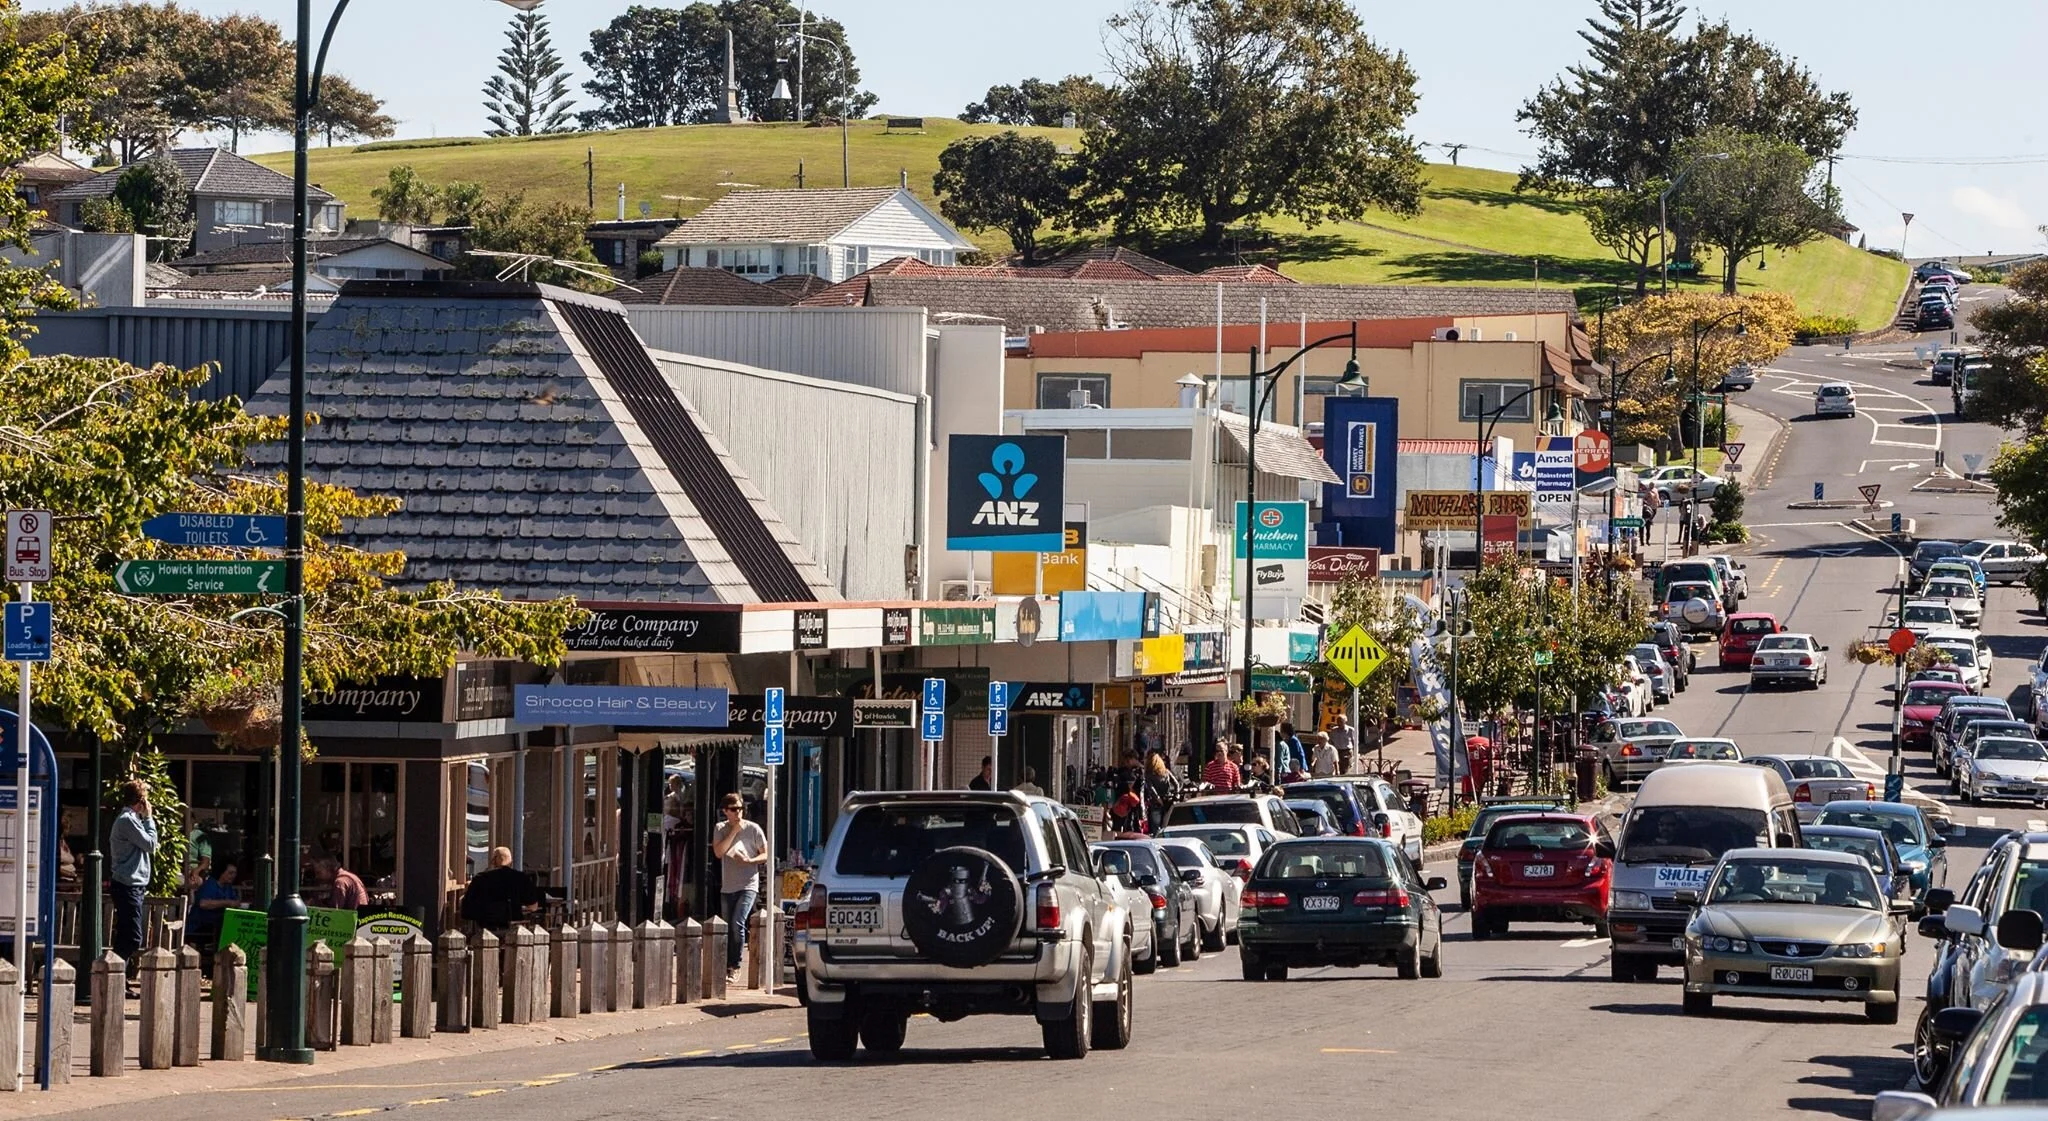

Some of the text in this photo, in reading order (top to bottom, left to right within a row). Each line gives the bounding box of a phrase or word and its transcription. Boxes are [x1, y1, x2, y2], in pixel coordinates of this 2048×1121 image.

[1537, 453, 1573, 464] Amcal
[1537, 480, 1571, 488] Pharmacy
[1538, 493, 1572, 503] OPEN
[971, 500, 1040, 526] ANZ
[179, 514, 234, 529] DISABLED
[185, 530, 229, 545] TOILETS
[9, 565, 47, 579] Bus Stop
[158, 562, 253, 577] Howick Information
[186, 577, 225, 591] Service
[20, 605, 35, 623] P
[24, 625, 32, 640] 5
[622, 614, 699, 638] Company
[7, 641, 31, 651] Loading
[574, 635, 599, 649] fresh
[598, 635, 621, 650] food
[623, 636, 649, 649] baked
[650, 636, 675, 650] daily
[930, 680, 938, 692] P
[995, 684, 1001, 696] P
[525, 694, 594, 709] Sirocco
[597, 695, 634, 709] Hair
[636, 696, 651, 709] &
[654, 697, 718, 713] Beauty
[771, 690, 778, 703] P
[1025, 691, 1064, 707] ANZ
[929, 715, 937, 725] P
[995, 711, 1001, 721] P
[770, 728, 778, 741] P
[1304, 896, 1340, 909] XX3799
[388, 911, 423, 927] Restaurant
[828, 910, 879, 925] EQC431
[371, 925, 409, 935] NOW OPEN
[936, 916, 996, 943] BACK UP!
